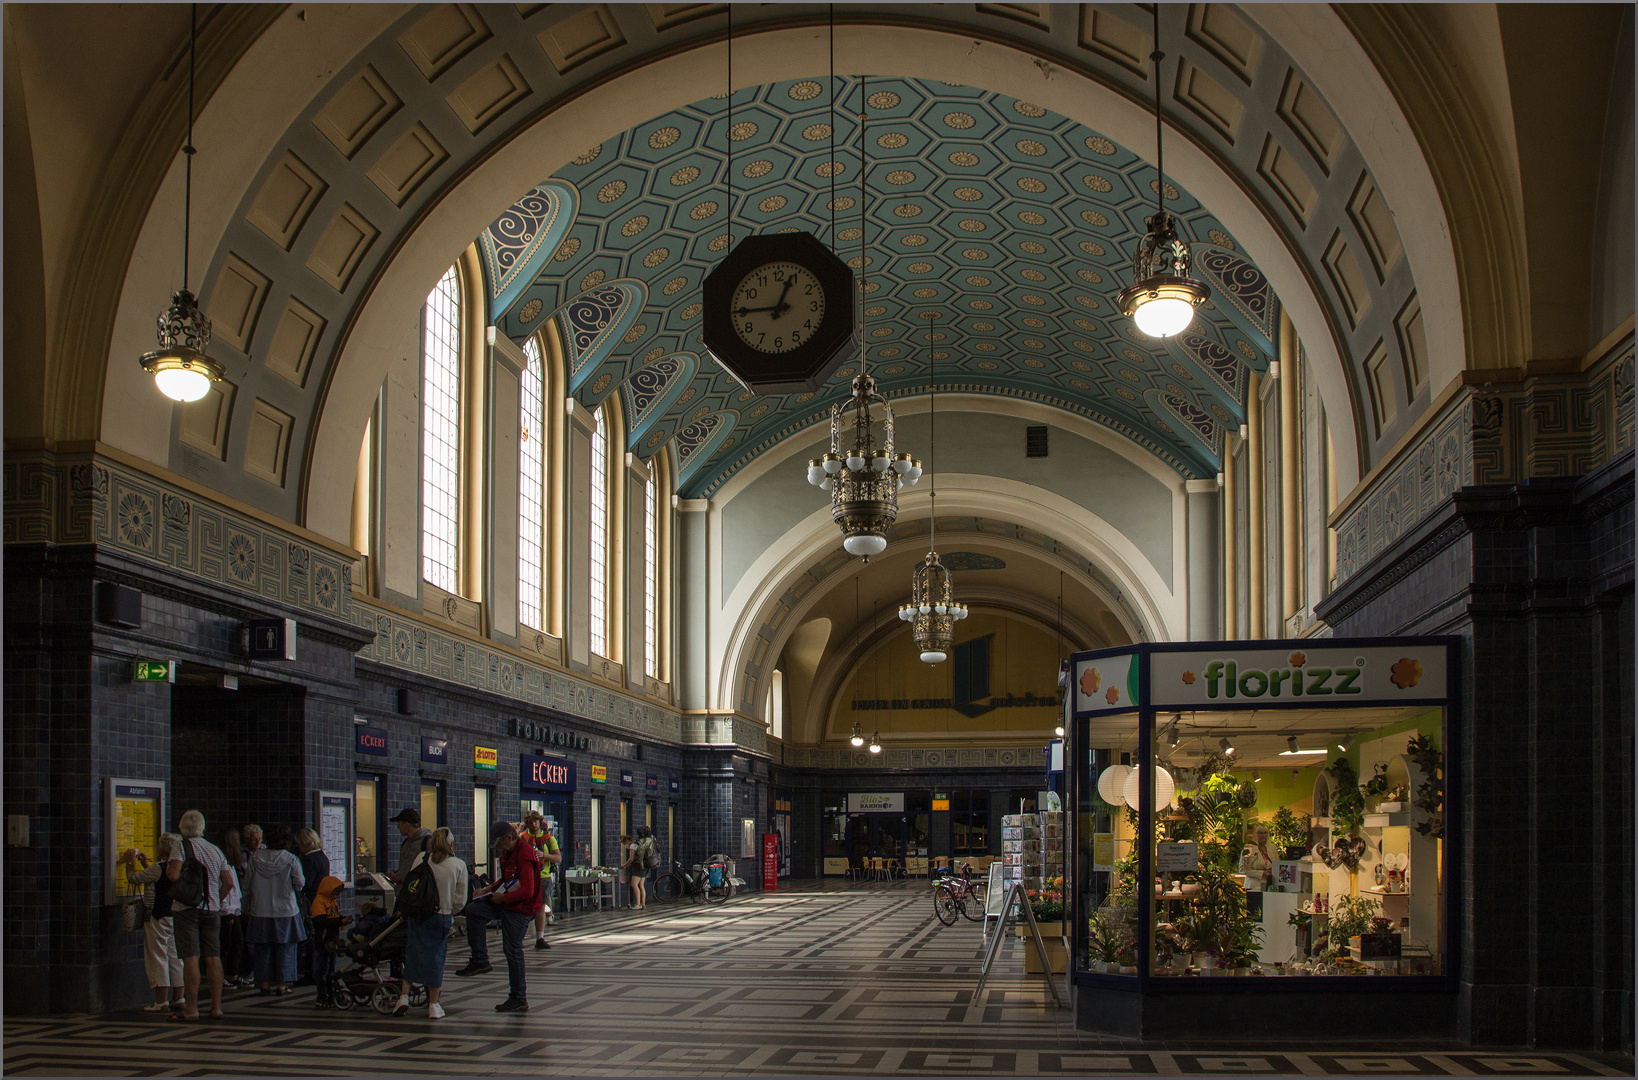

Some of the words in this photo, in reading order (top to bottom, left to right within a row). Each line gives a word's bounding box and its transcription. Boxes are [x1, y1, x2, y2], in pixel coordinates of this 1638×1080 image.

[757, 275, 768, 287] 11
[773, 270, 784, 282] 12
[792, 272, 798, 284] 1
[745, 288, 757, 300] 10
[805, 284, 813, 296] 2
[810, 300, 818, 312] 3
[745, 322, 753, 333] 8
[803, 319, 812, 330] 4
[758, 332, 766, 344] 7
[774, 336, 783, 348] 6
[791, 331, 800, 342] 5
[1204, 652, 1362, 698] florizz
[852, 699, 888, 710] IMMER
[890, 699, 908, 709] EIN
[911, 698, 951, 709] GENUSS
[514, 717, 593, 751] Fahrkarten
[360, 734, 385, 748] ECKERT
[428, 745, 443, 756] BUCH
[482, 750, 496, 761] LOTTO
[532, 760, 569, 785] ECKERT
[859, 794, 878, 804] Bio
